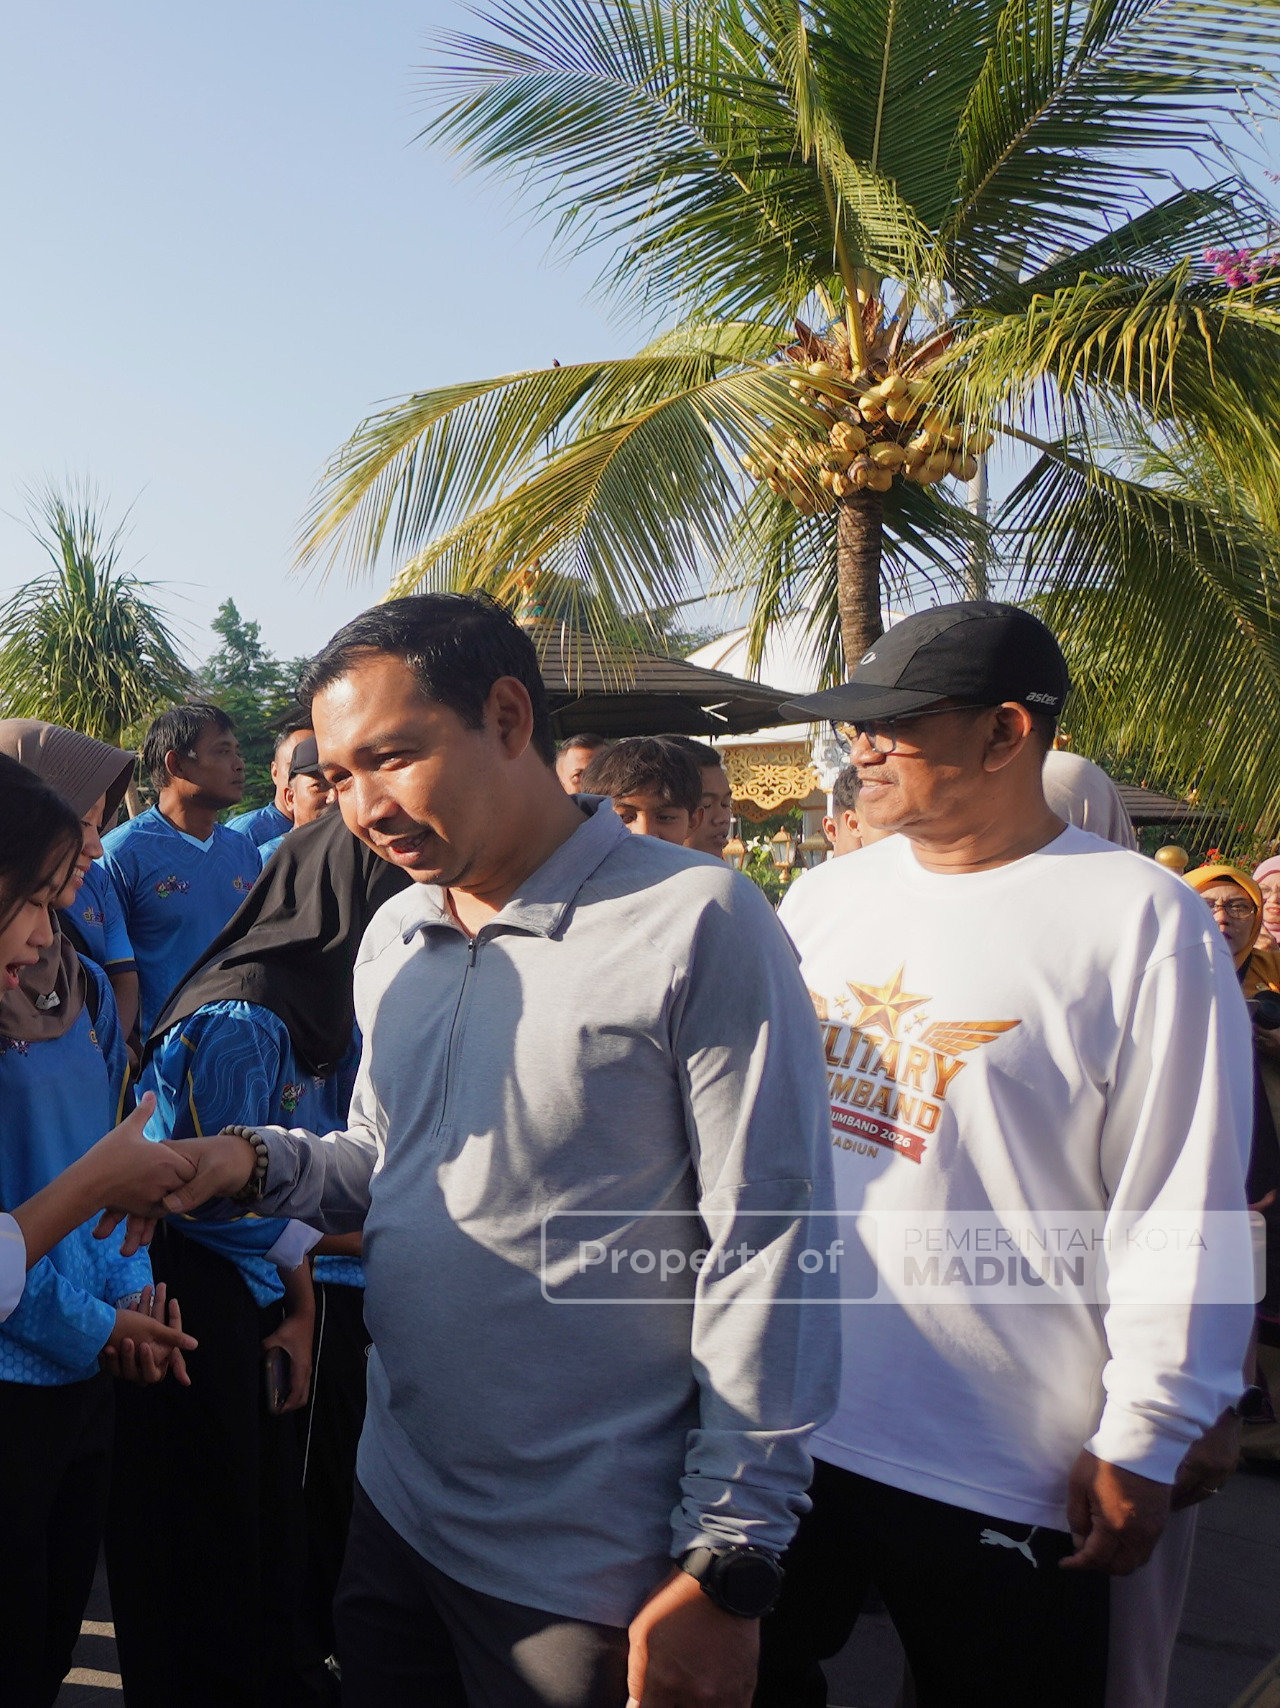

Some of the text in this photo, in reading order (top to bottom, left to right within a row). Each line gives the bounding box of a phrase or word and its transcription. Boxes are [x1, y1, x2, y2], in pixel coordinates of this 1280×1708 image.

[822, 1024, 967, 1101] LITARY
[826, 1071, 942, 1134] MBAND
[831, 1111, 911, 1148] UMBAND 2026
[833, 1135, 879, 1159] ADIUN
